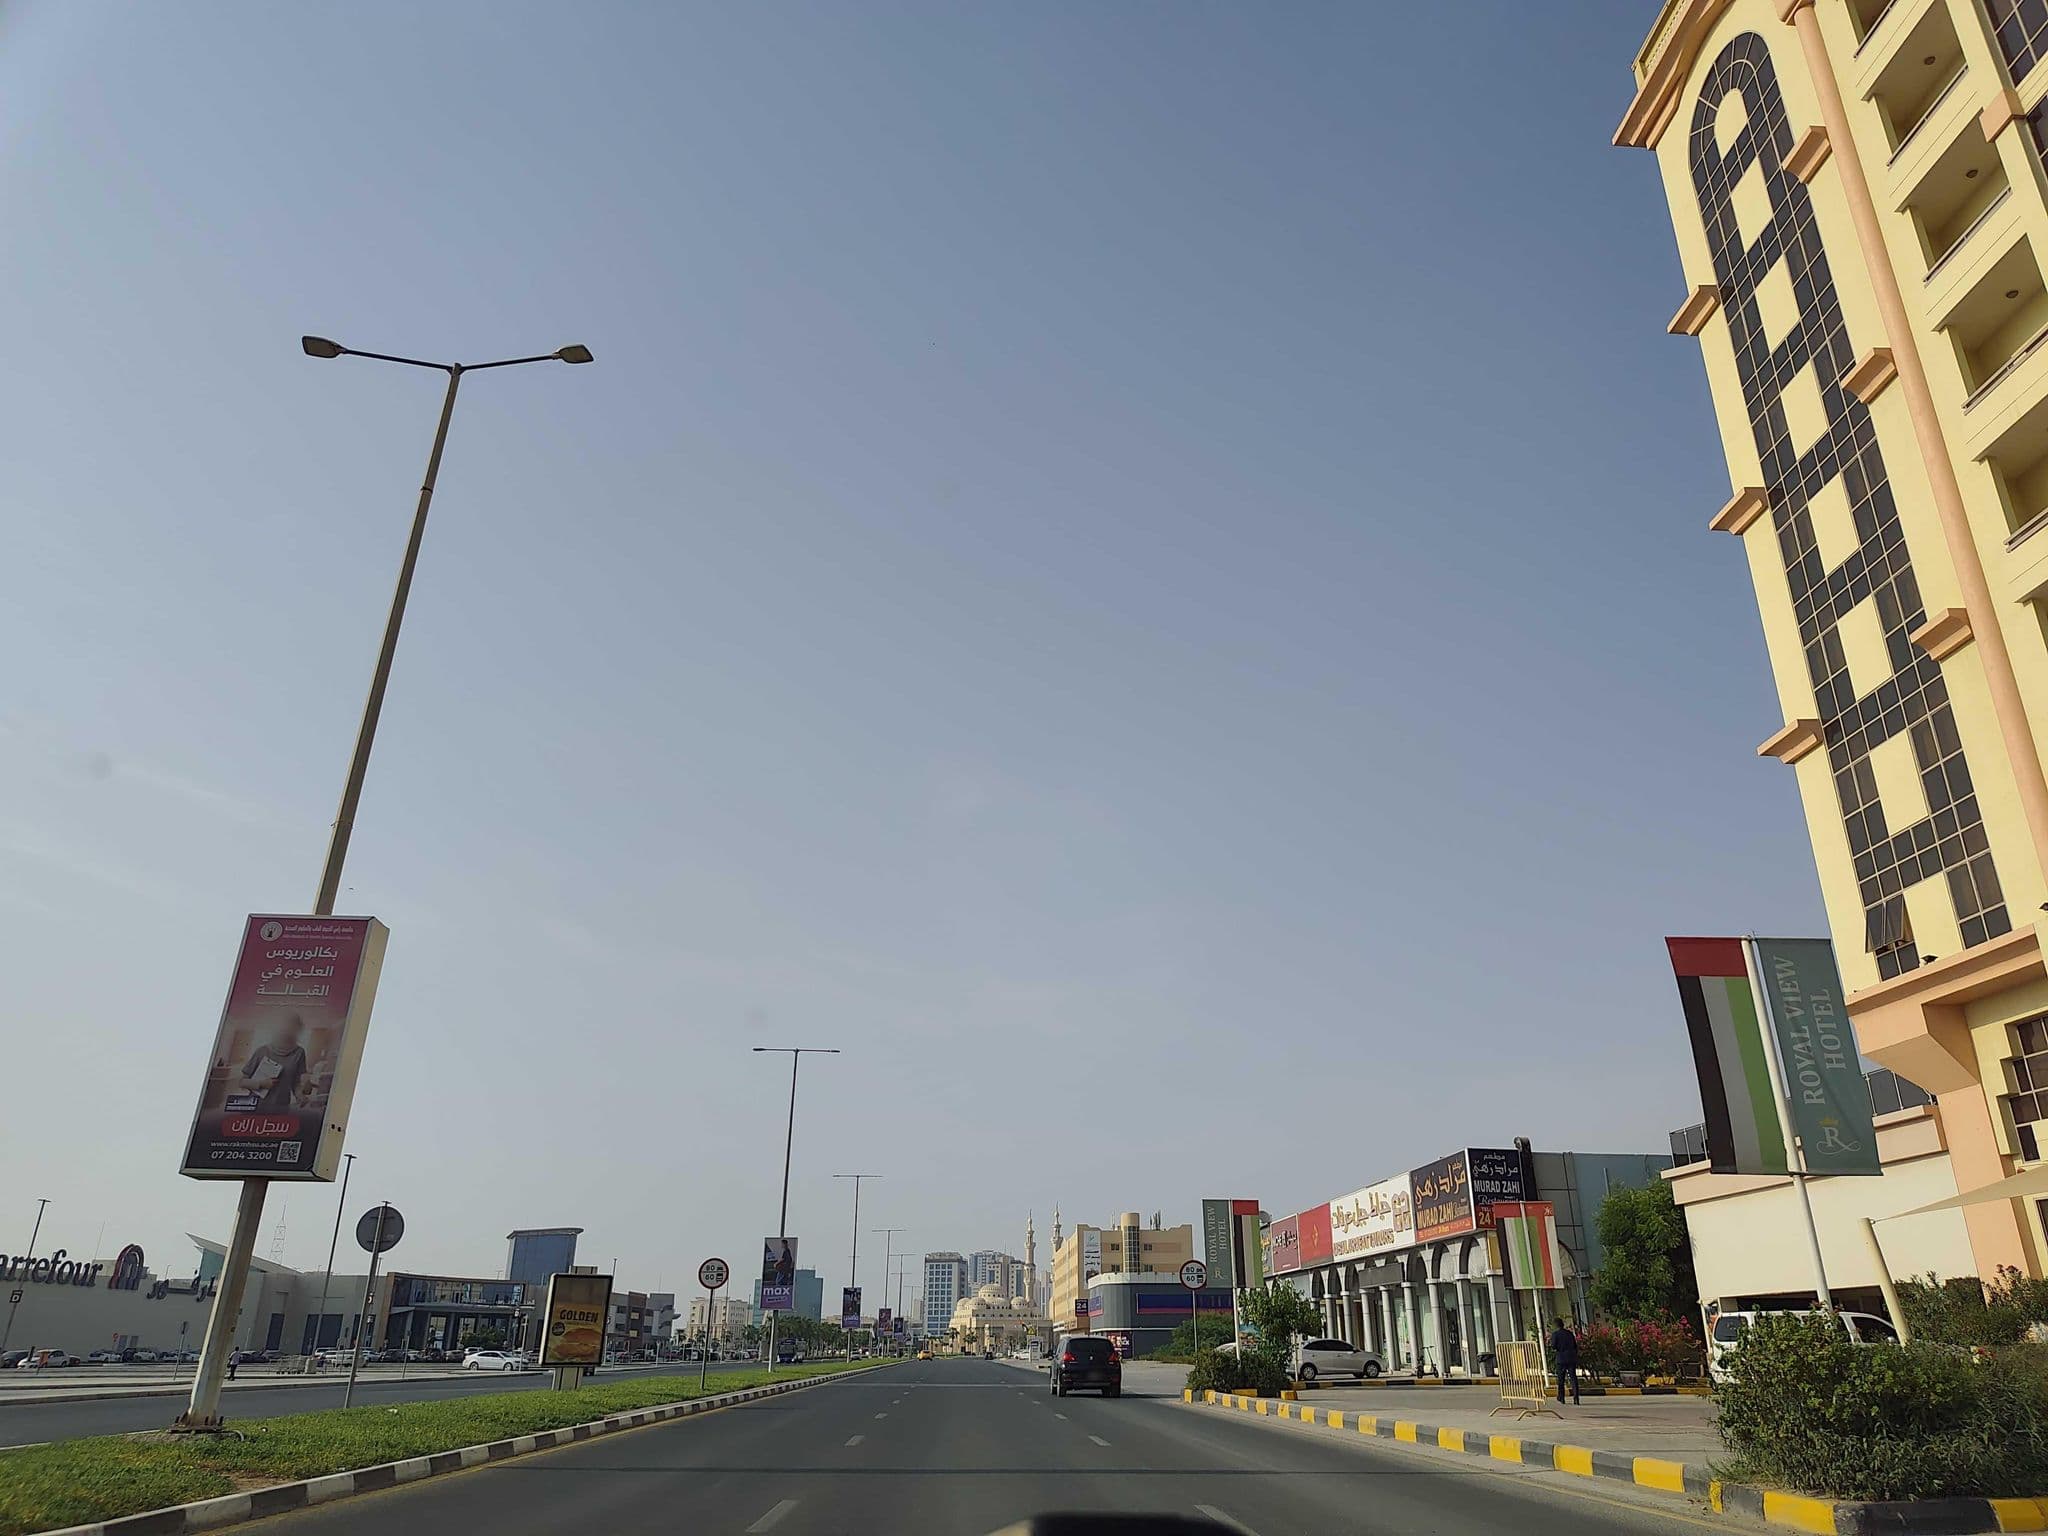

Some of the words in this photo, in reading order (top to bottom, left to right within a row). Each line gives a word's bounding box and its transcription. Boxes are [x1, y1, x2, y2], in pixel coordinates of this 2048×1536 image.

[266, 946, 338, 960] بكالوريوس
[261, 963, 282, 981] في
[284, 965, 334, 979] العلوم
[1773, 955, 1805, 1020] VIEW
[1809, 988, 1847, 1070] HOTEL
[1790, 1025, 1826, 1104] ROYAL
[255, 1119, 290, 1136] سجل
[211, 1151, 225, 1159] 07
[226, 1151, 245, 1159] 204
[247, 1151, 273, 1160] 3200
[1494, 1162, 1519, 1177] مراد
[1439, 1163, 1467, 1194] مراد
[1473, 1180, 1501, 1193] MURAD
[1502, 1181, 1520, 1194] ZAHI
[1207, 1206, 1216, 1233] VIEW
[1416, 1206, 1439, 1229] MURAD
[1439, 1201, 1454, 1223] ZAHI
[1479, 1211, 1491, 1225] 24
[1218, 1218, 1227, 1250] HOTEL
[1208, 1235, 1217, 1262] ROYAL
[704, 1273, 715, 1281] 60
[763, 1286, 791, 1297] max
[560, 1309, 599, 1323] GOLDEN
